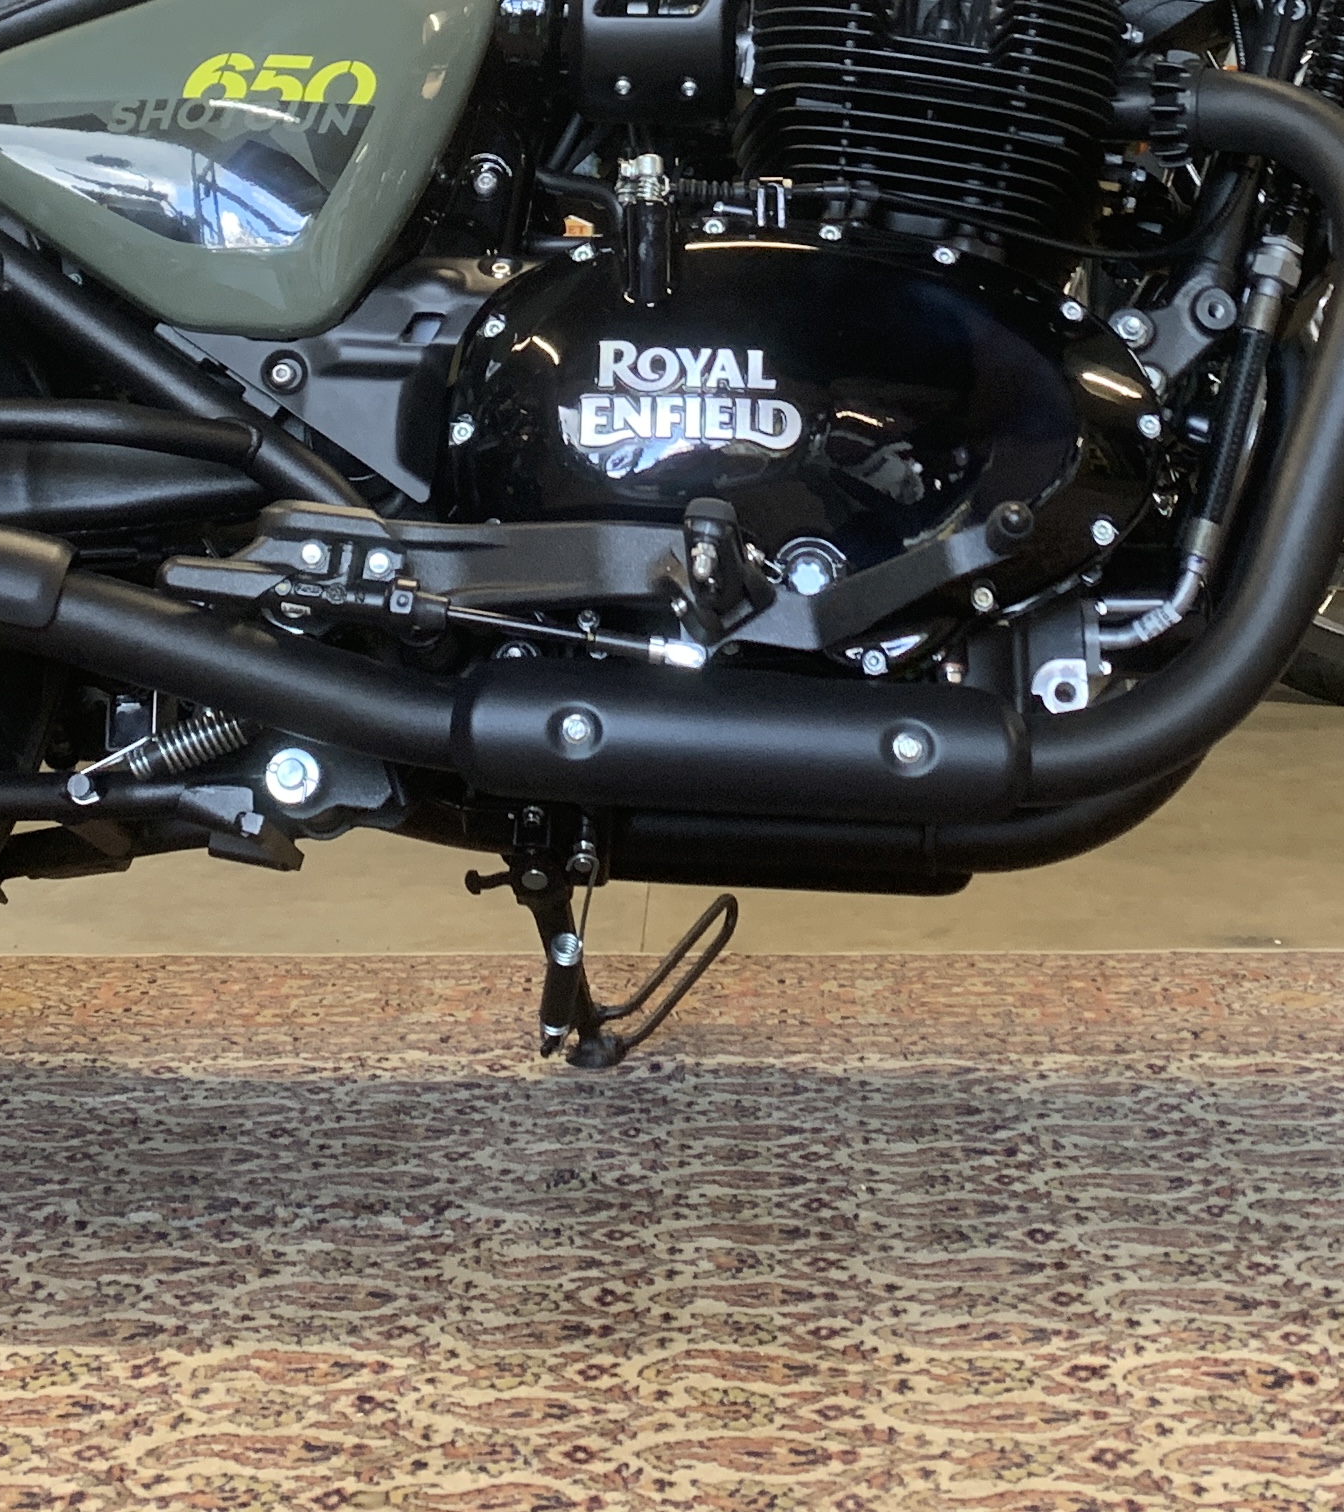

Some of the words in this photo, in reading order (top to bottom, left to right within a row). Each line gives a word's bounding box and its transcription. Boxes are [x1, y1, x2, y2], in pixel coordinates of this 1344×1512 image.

[183, 52, 377, 106] 650
[107, 97, 358, 136] SHOTGUN
[597, 339, 777, 392] ROYAL
[578, 393, 803, 450] ENFIELD
